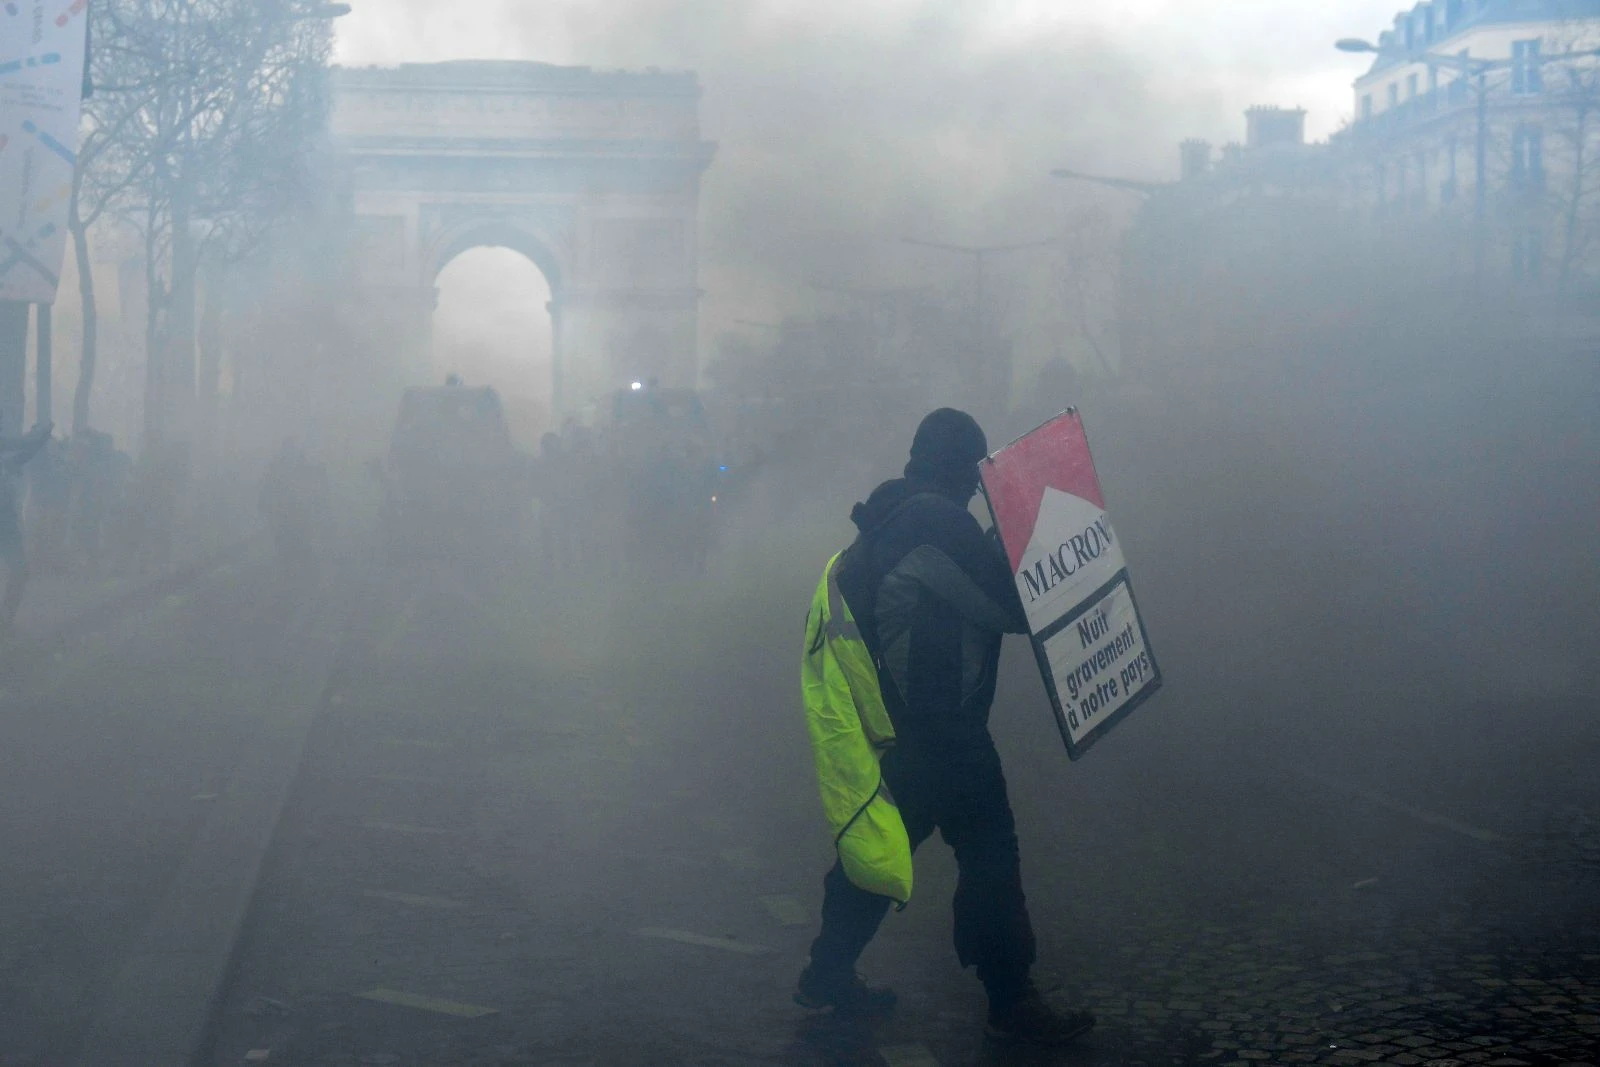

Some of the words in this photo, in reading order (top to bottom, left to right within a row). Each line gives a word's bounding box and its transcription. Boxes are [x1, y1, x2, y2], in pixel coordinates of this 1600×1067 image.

[1021, 514, 1112, 602] MACRON
[1066, 624, 1136, 701] gravement
[1077, 608, 1110, 650] Nuit
[1066, 703, 1080, 731] à
[1082, 677, 1119, 716] notre
[1121, 651, 1149, 691] pays
